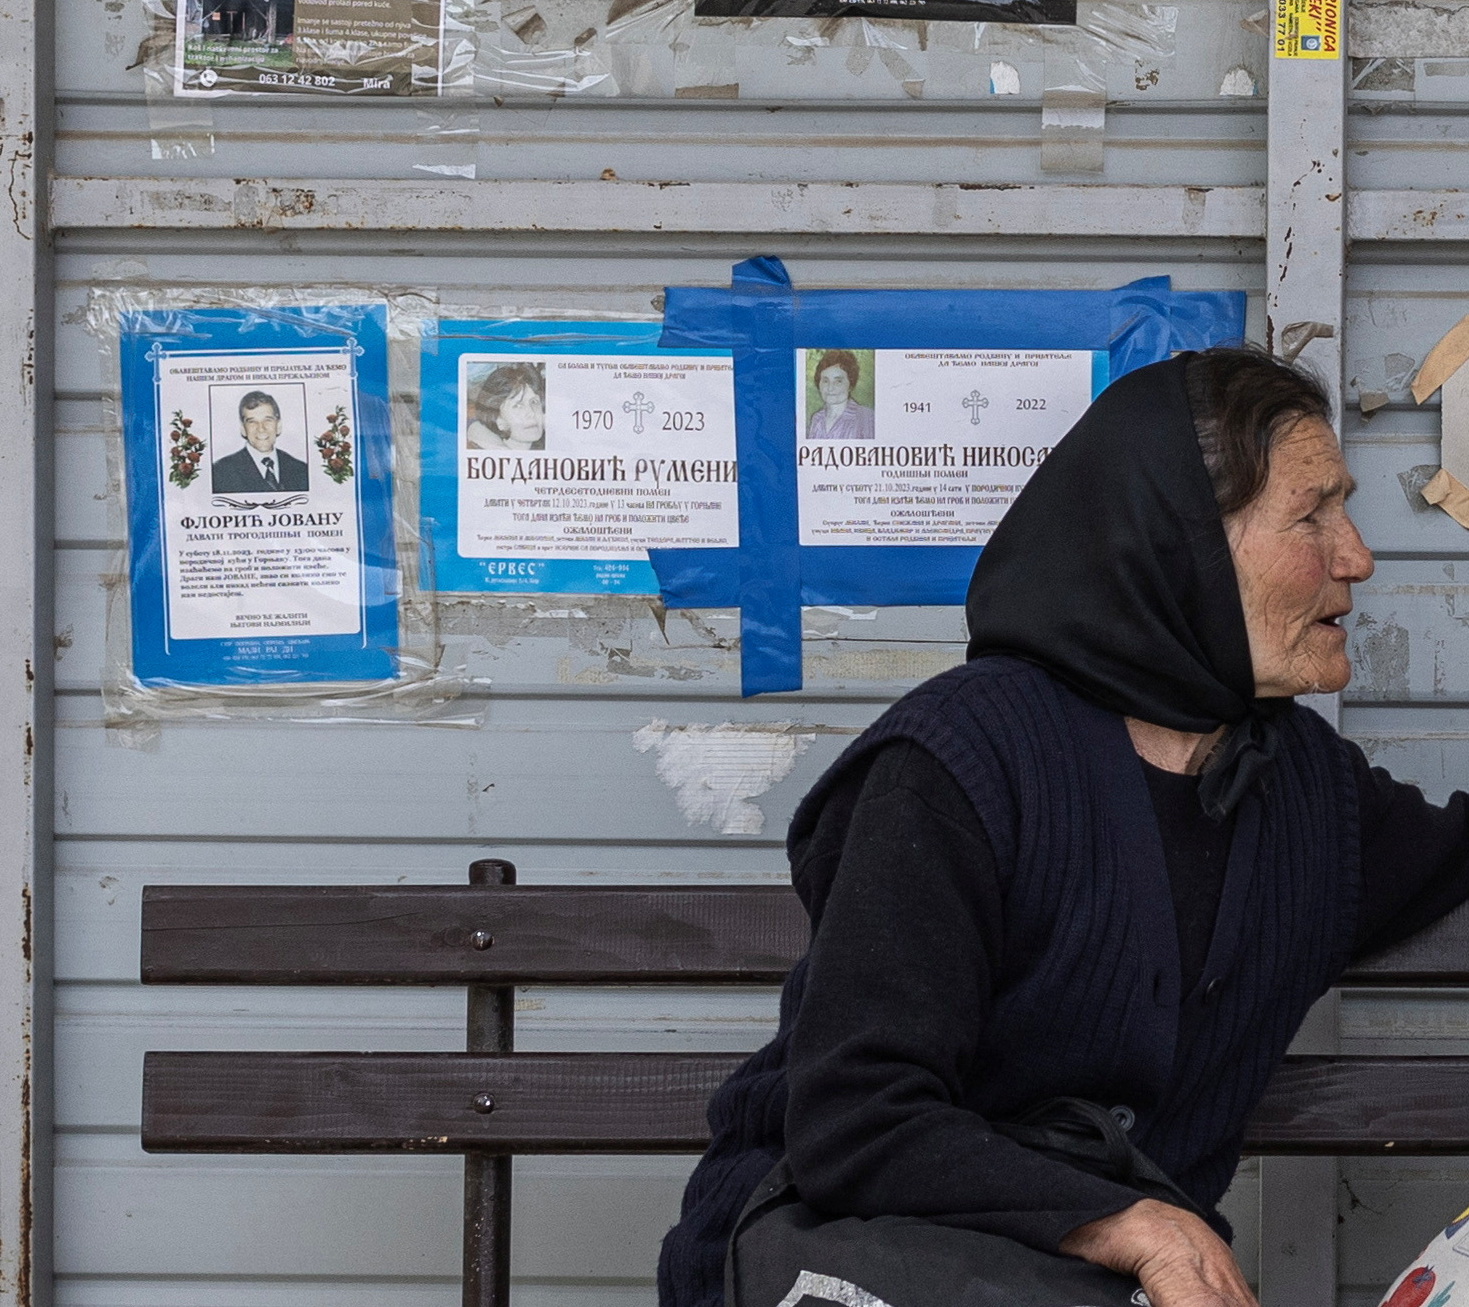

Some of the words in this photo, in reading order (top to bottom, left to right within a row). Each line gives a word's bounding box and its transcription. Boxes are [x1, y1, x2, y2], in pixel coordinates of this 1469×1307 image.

[1278, 23, 1285, 35] 77
[1277, 39, 1285, 51] 01
[259, 73, 279, 85] 063
[281, 74, 294, 85] 12
[297, 74, 311, 85] 42
[314, 75, 336, 86] 802
[363, 75, 391, 90] Mira
[466, 457, 627, 483] БОГДАНОВИЋ
[635, 460, 737, 489] РУМЕНИ
[180, 514, 262, 529] ФЛОРИЋ
[268, 513, 343, 528] ЈОВАНУ
